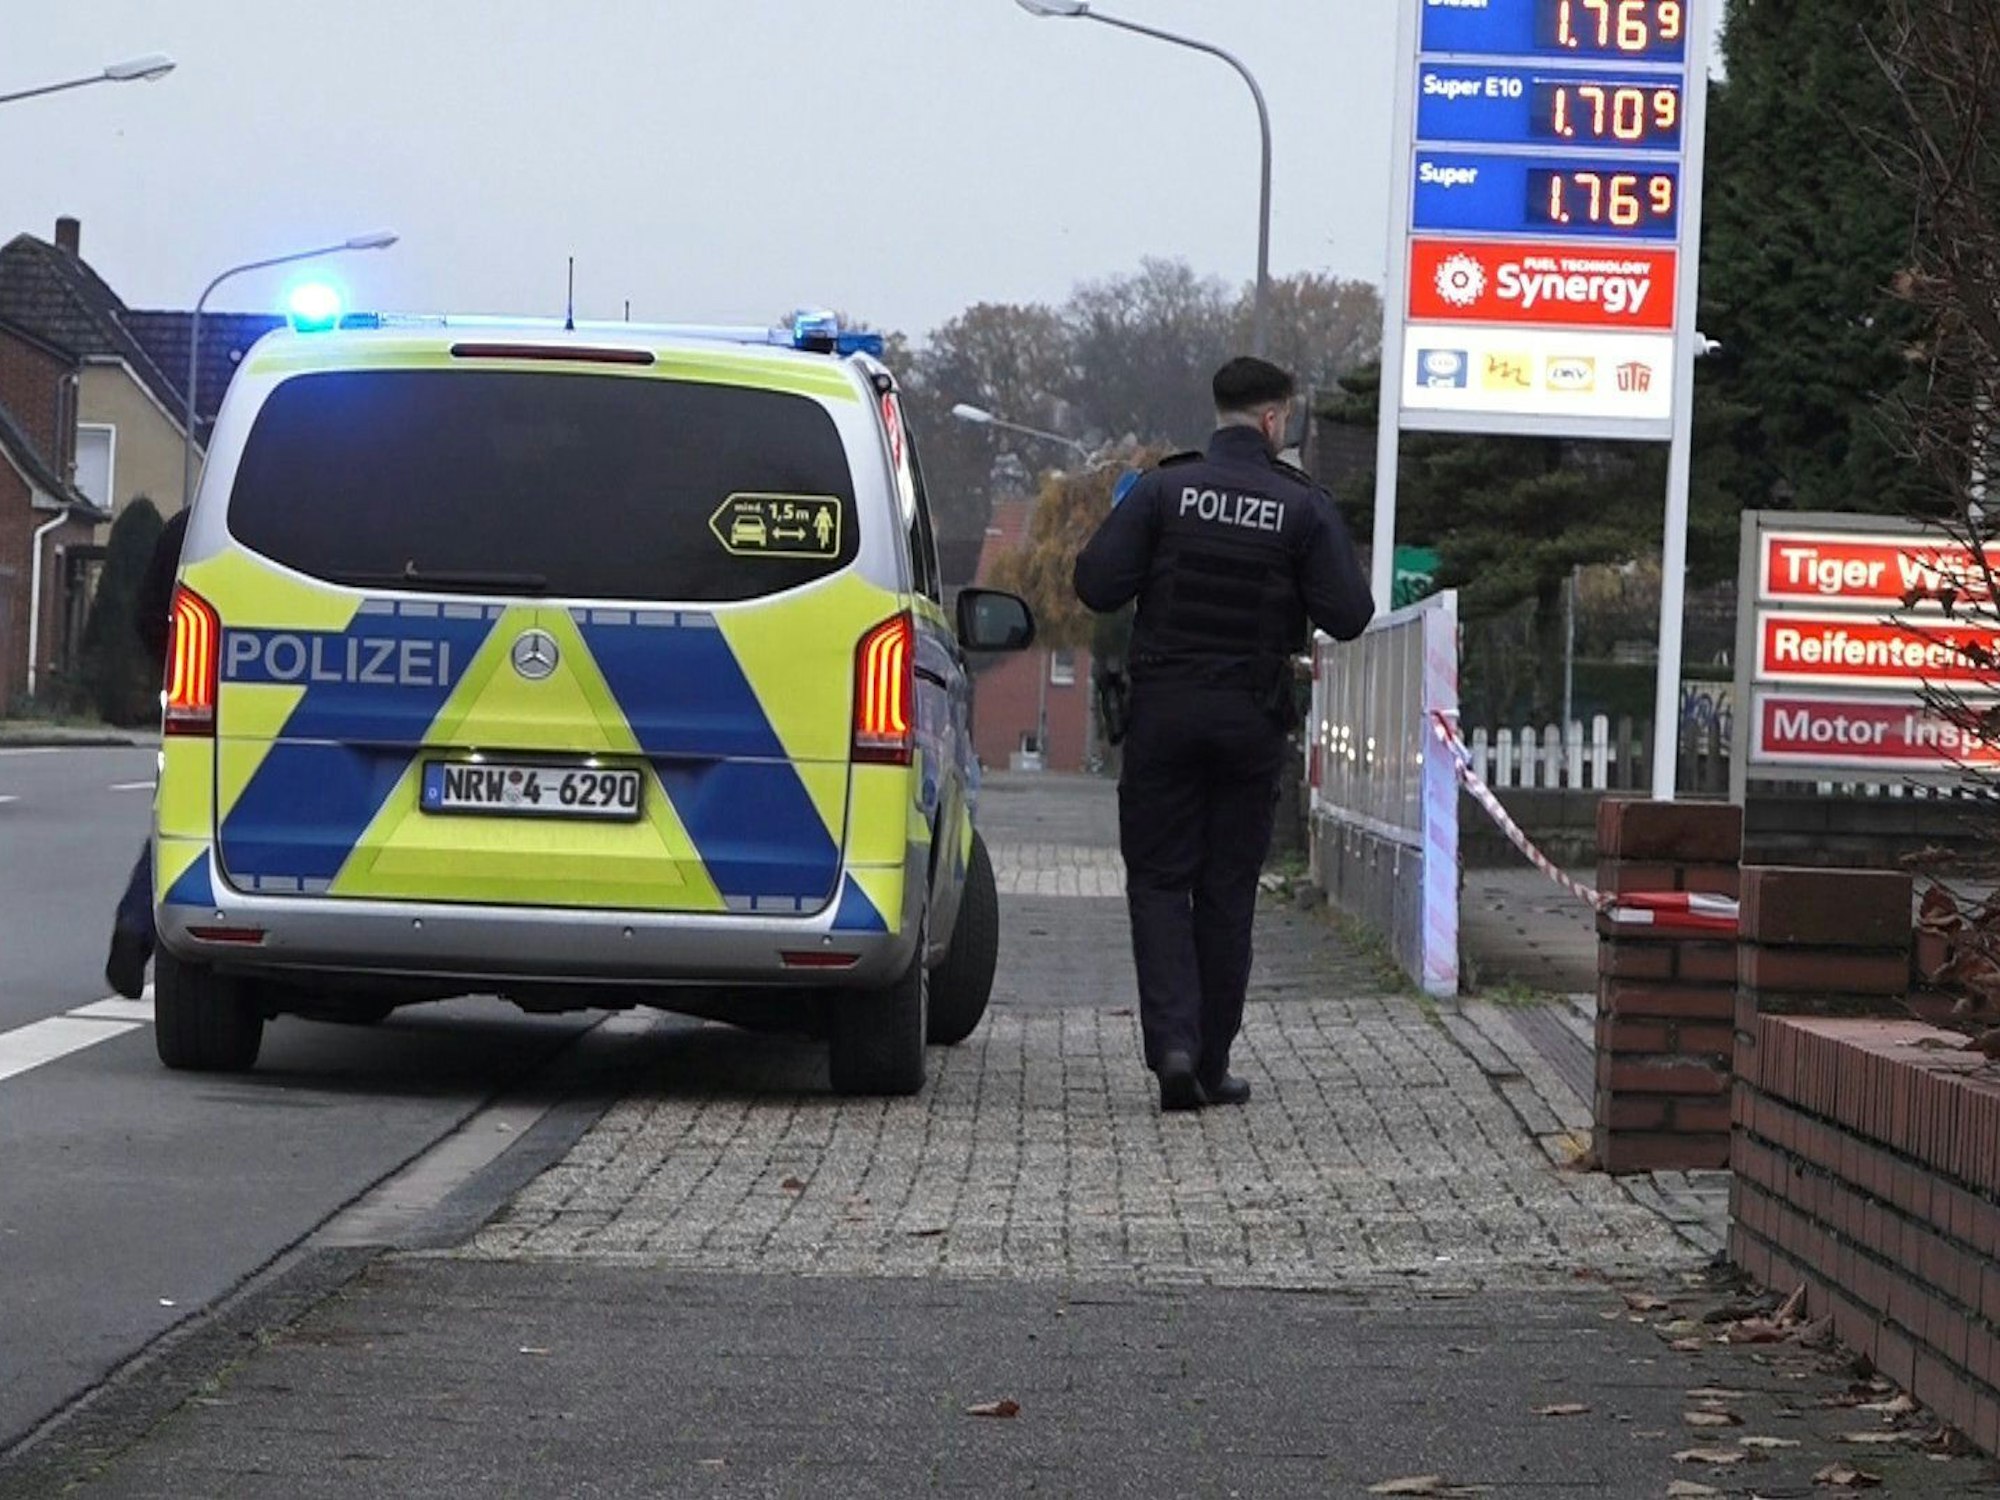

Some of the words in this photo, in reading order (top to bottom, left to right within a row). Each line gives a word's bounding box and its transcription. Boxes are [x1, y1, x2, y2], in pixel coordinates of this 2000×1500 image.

[1423, 74, 1481, 99] Super
[1485, 76, 1522, 98] E10
[1419, 162, 1478, 187] Super
[1523, 256, 1558, 271] FUEL
[1560, 258, 1651, 275] TECHNOLOGY
[1496, 263, 1651, 314] Synergy
[1616, 361, 1652, 392] UTA
[1179, 487, 1285, 532] POLIZEI
[1781, 548, 1886, 593] Tiger
[226, 633, 450, 687] POLIZEI
[1773, 709, 1888, 744] Motor
[1904, 714, 2000, 756] Insp
[443, 768, 505, 803] NRW
[522, 772, 638, 808] 4-6290
